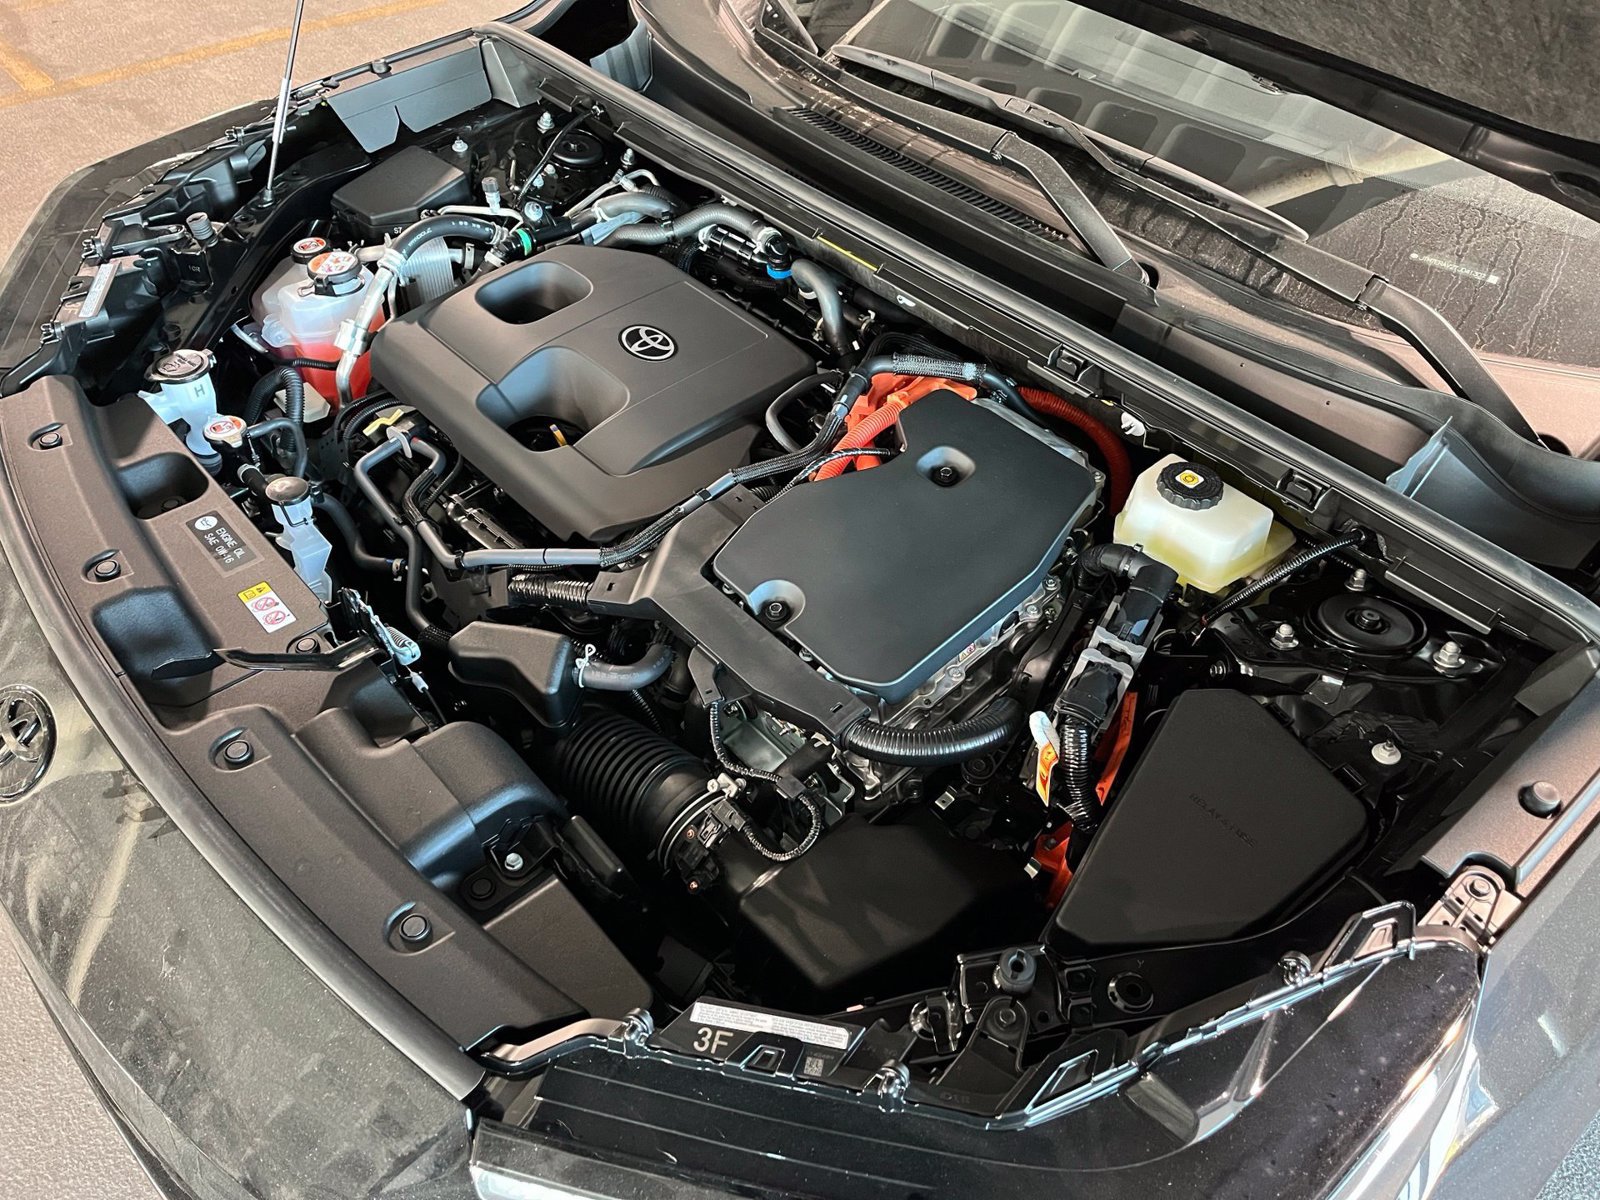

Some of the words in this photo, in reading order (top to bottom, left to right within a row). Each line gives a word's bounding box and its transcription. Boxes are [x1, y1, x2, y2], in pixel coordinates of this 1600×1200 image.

[194, 384, 206, 398] H
[204, 533, 219, 545] SAE
[215, 527, 237, 547] ENGINE
[233, 547, 246, 559] OIL
[693, 1027, 734, 1055] 3F
